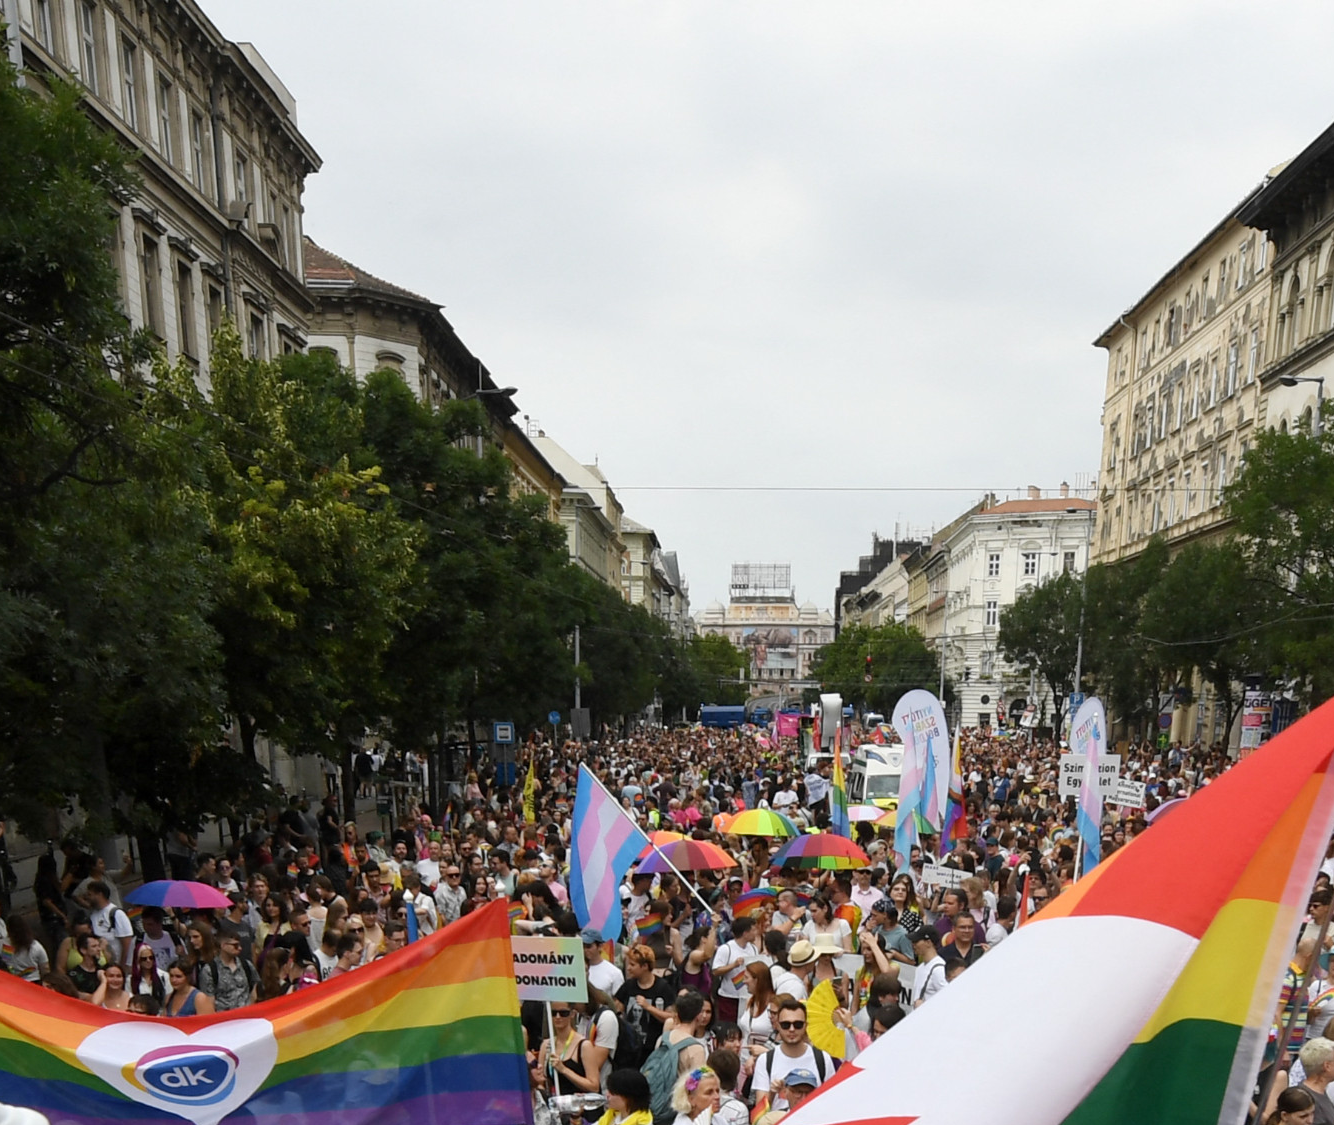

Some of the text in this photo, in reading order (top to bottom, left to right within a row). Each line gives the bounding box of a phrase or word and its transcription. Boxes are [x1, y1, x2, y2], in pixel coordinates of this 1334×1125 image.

[1064, 763, 1116, 774] Szimzion
[1067, 776, 1111, 788] Egylet
[513, 951, 574, 965] ADOMÁNY
[515, 975, 576, 987] DONATION
[160, 1066, 215, 1088] dk
